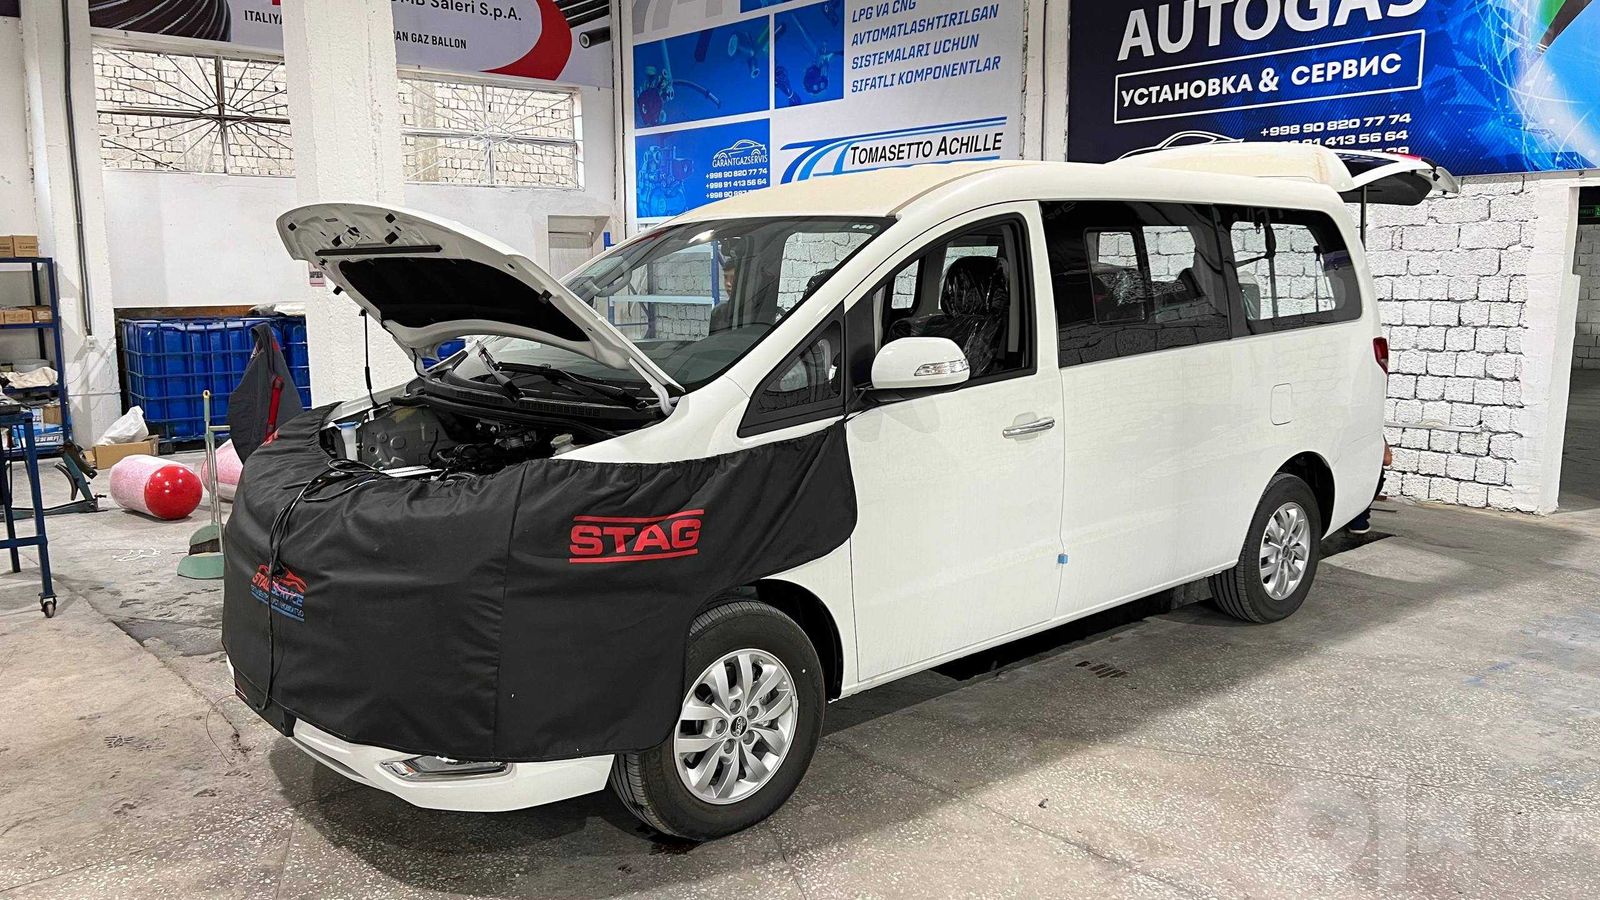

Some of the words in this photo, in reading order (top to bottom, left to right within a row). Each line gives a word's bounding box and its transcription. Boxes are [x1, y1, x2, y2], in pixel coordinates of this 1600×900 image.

[480, 2, 522, 20] S.p.A.
[852, 6, 873, 23] LPG
[876, 3, 889, 17] VA
[892, 0, 916, 14] CNG
[852, 4, 999, 46] AVTOMATLASHTIRILGAN
[411, 33, 429, 45] GAZ
[431, 35, 467, 49] BALLON
[852, 43, 930, 69] SISTEMALARI
[933, 33, 980, 55] UCHUN
[851, 73, 895, 93] SIFATLI
[898, 55, 1001, 85] KOMPONENTLAR
[1121, 73, 1253, 107] УСТАНОВКА
[1258, 67, 1279, 92] &
[1291, 53, 1402, 86] СЕРВИС
[1261, 124, 1300, 136] +998
[1303, 122, 1325, 133] 90
[1327, 118, 1360, 130] 820
[1363, 115, 1385, 127] 77
[1389, 113, 1411, 125] 74
[1325, 134, 1356, 146] 413
[1359, 132, 1381, 143] 56
[1385, 130, 1408, 142] 64
[850, 140, 932, 165] TOMASETTO
[936, 132, 1003, 157] ACHILLE
[733, 169, 747, 177] 820
[570, 518, 702, 556] STAG
